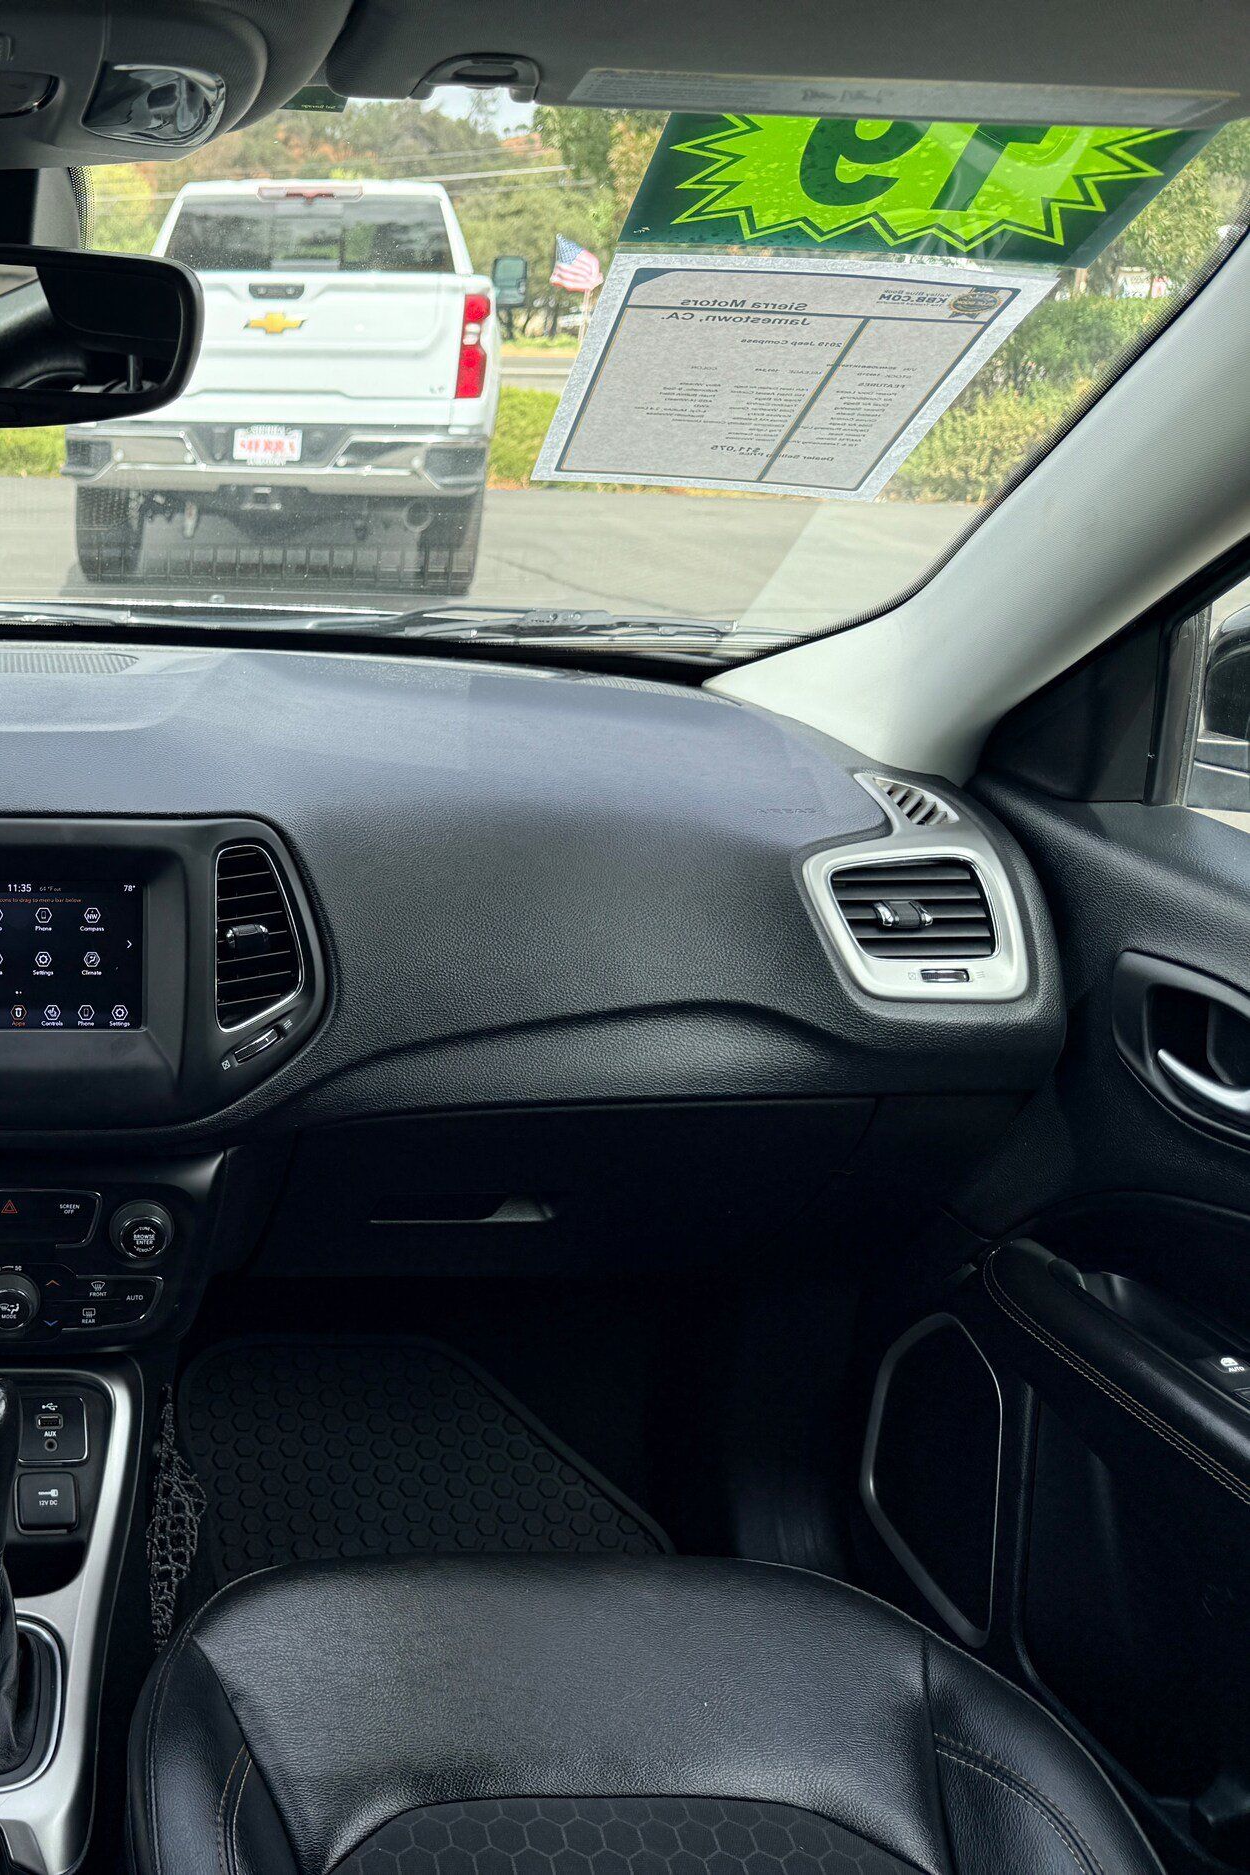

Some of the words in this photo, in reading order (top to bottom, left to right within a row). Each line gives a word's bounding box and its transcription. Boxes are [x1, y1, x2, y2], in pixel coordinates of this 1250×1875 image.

[8, 883, 32, 893] 11:35
[32, 969, 54, 977] Settings
[109, 1020, 130, 1028] Settings
